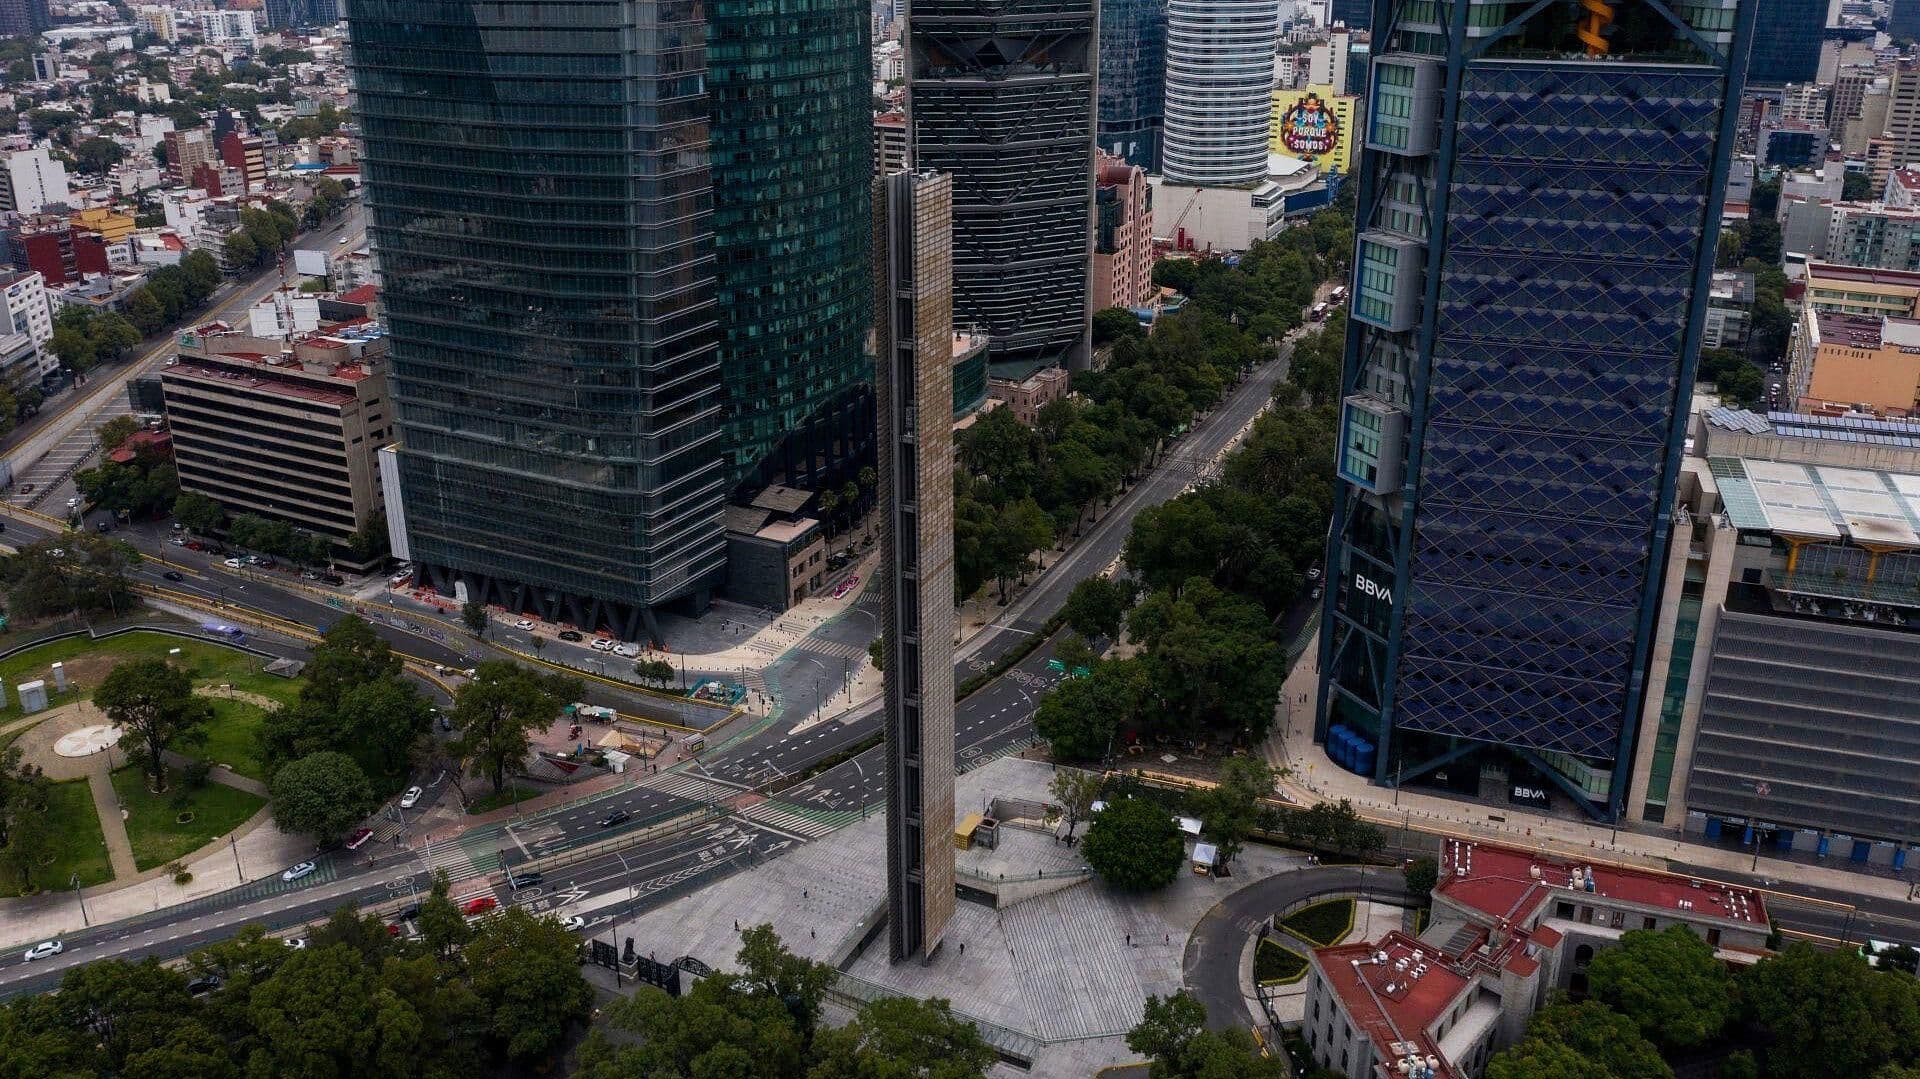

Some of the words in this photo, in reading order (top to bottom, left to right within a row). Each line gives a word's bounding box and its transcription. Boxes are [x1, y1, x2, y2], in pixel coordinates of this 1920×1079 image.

[1302, 113, 1319, 123] SOY
[1292, 127, 1327, 137] PORQUE
[1294, 139, 1323, 150] SOMOS
[1355, 573, 1393, 605] BBVA
[1514, 786, 1546, 799] BBVA
